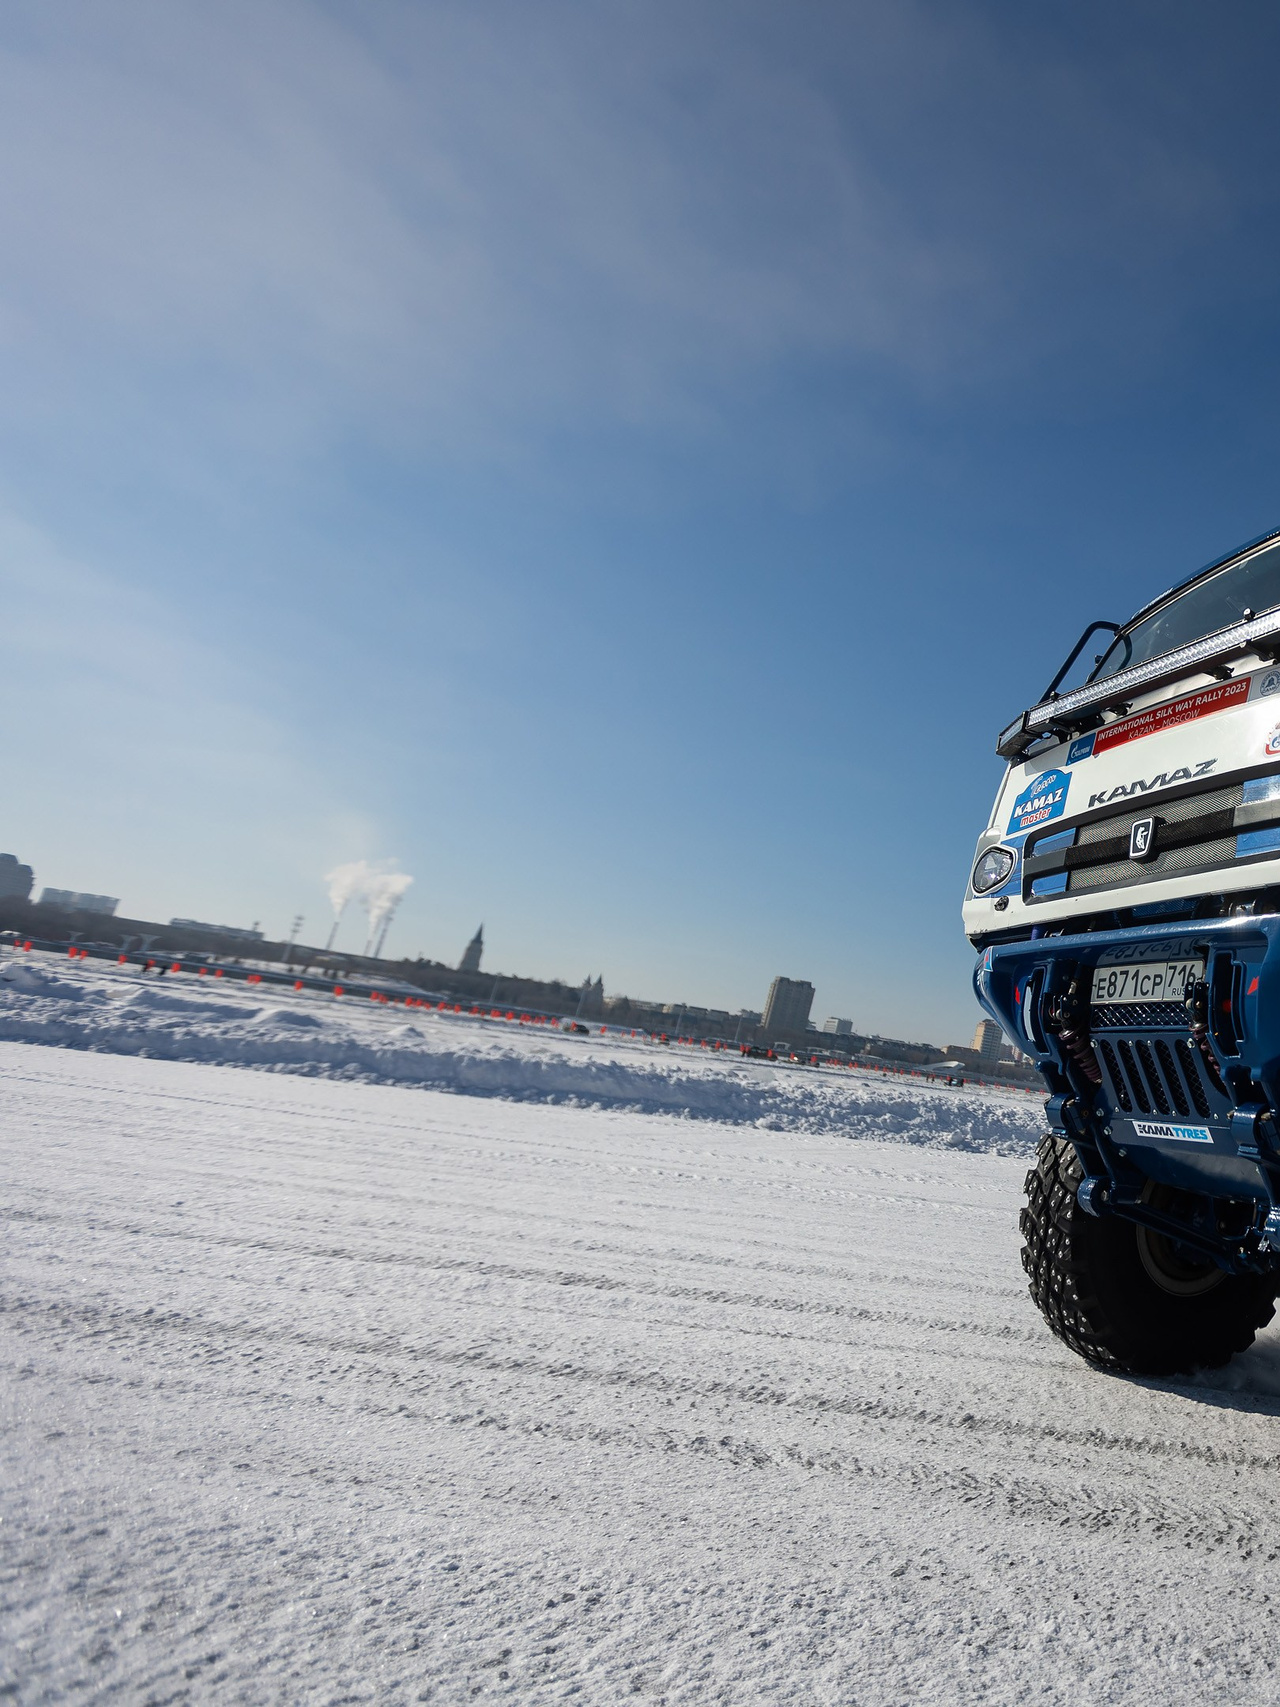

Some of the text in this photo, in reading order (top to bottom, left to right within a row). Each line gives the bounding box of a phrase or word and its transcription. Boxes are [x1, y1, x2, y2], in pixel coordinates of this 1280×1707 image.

[1097, 682, 1247, 741] INTERNATIONAL SILK WAY RALLY 2023
[1128, 725, 1155, 740] KAZAN
[1161, 709, 1200, 728] MOSCOW
[1030, 774, 1057, 798] Team
[1087, 757, 1219, 809] KAMAZ
[1013, 787, 1064, 818] KAMAZ
[1019, 807, 1053, 828] master
[1167, 964, 1196, 988] 716
